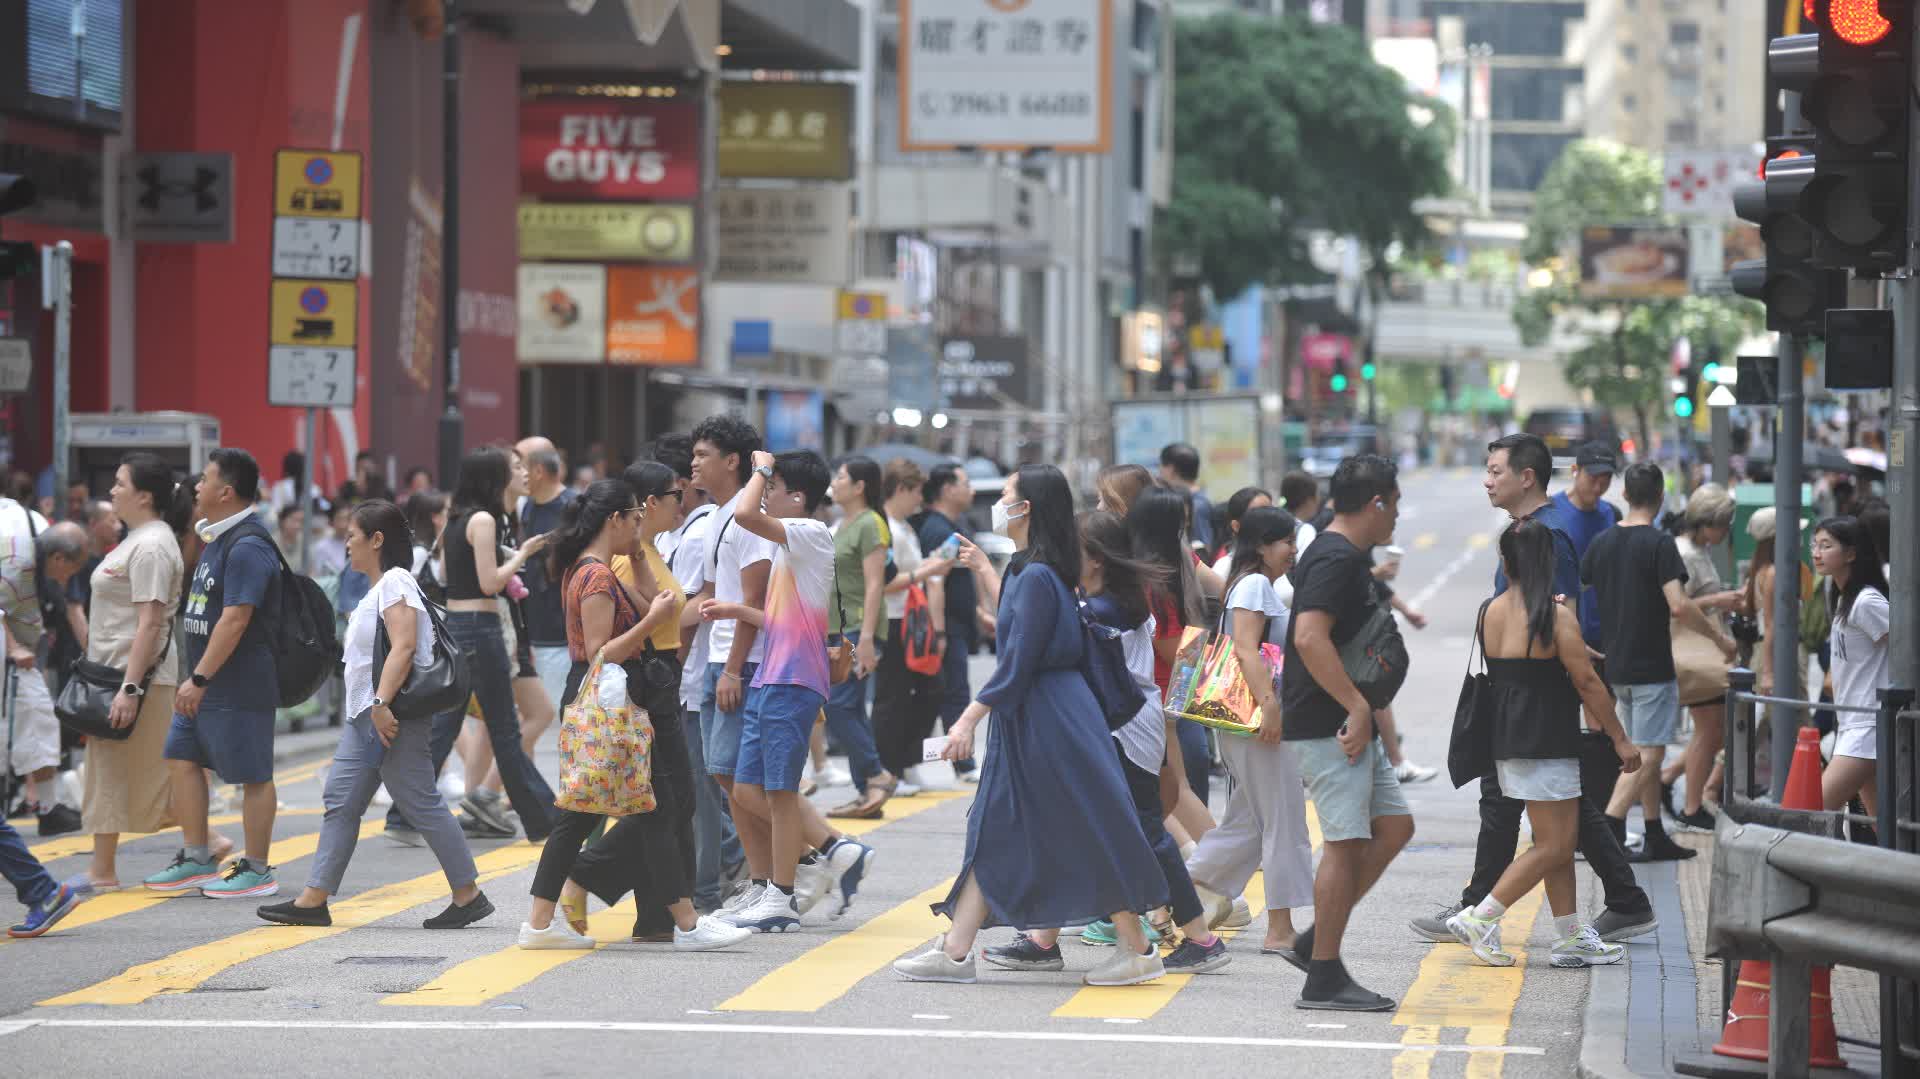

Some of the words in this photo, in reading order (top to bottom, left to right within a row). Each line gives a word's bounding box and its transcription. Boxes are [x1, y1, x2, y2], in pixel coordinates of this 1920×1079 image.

[560, 115, 657, 147] FIVE
[544, 150, 667, 184] GUYS
[327, 222, 342, 243] 7
[327, 254, 353, 274] 12
[324, 350, 340, 371] 7
[323, 382, 339, 402] 7
